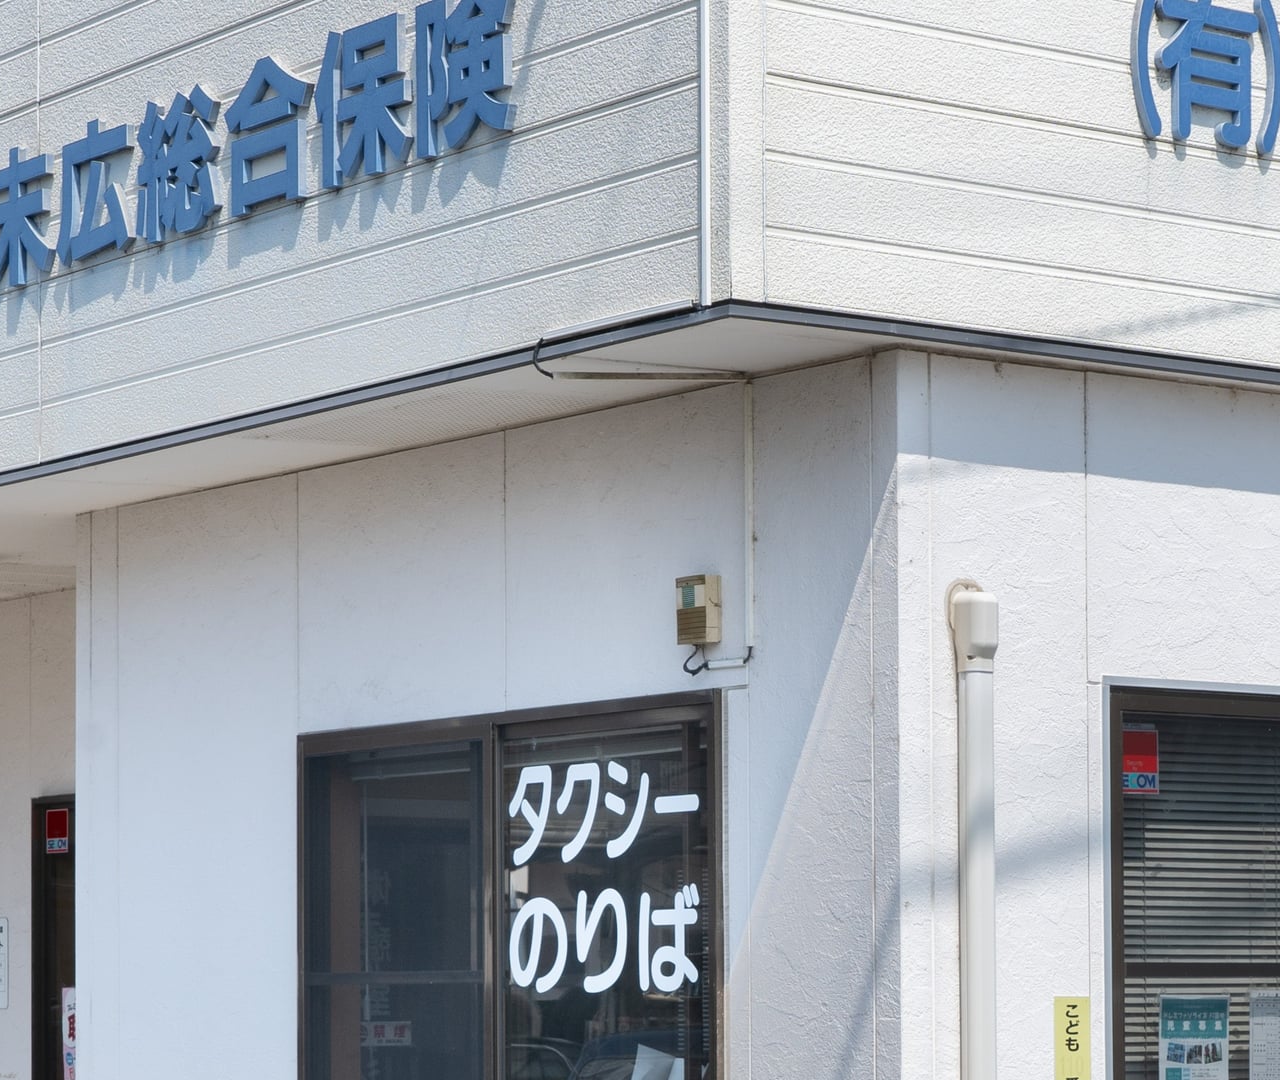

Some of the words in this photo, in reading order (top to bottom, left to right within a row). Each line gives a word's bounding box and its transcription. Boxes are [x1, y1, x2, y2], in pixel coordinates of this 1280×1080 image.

[509, 760, 700, 866] タクシー
[509, 883, 700, 994] のりば
[1065, 1004, 1080, 1052] こども
